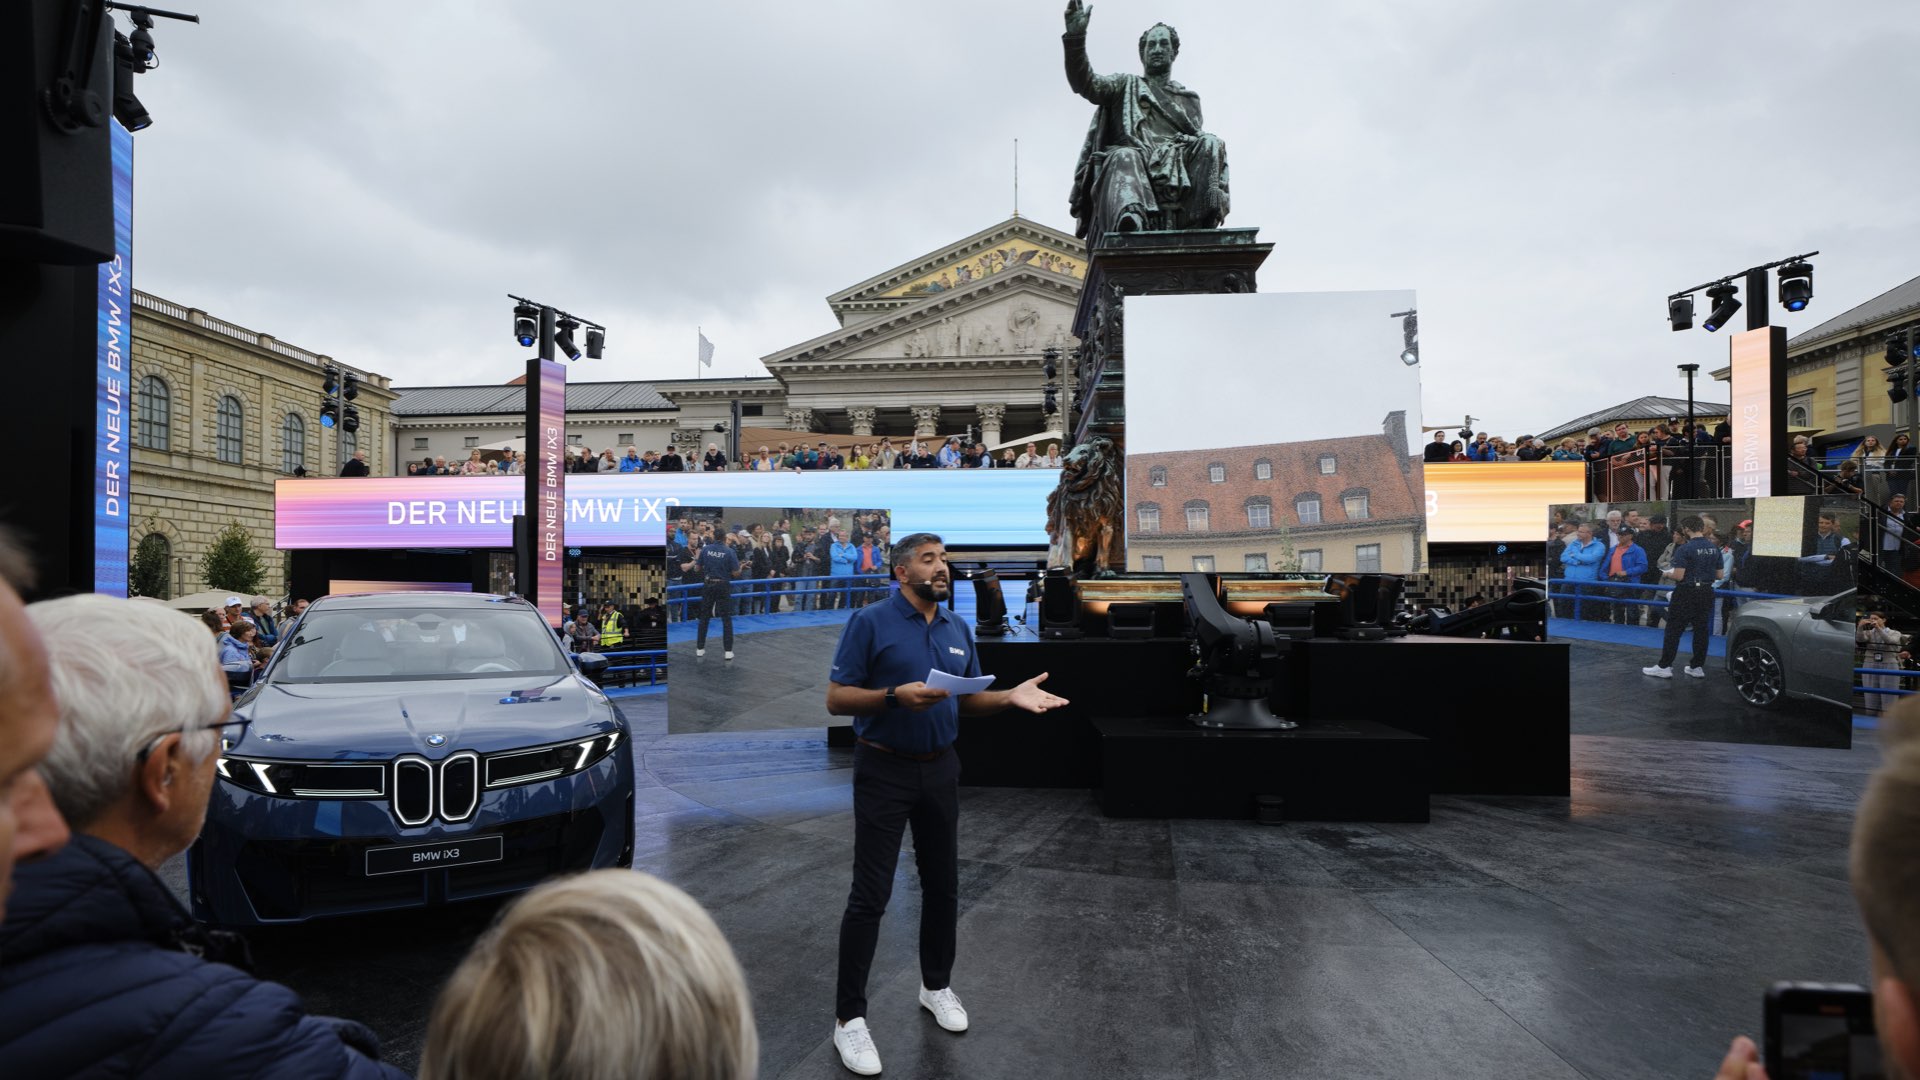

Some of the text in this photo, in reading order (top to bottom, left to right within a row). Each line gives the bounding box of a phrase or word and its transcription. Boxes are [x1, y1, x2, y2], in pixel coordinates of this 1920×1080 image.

[107, 299, 122, 371] BMW
[107, 377, 121, 453] NEUE
[1744, 433, 1759, 472] BMW
[106, 460, 120, 516] DER
[545, 427, 558, 561] DER NEUE BMW iX3
[388, 501, 447, 526] DER
[564, 498, 624, 523] MW
[949, 646, 965, 656] BMW
[412, 848, 460, 863] BMW iX3
